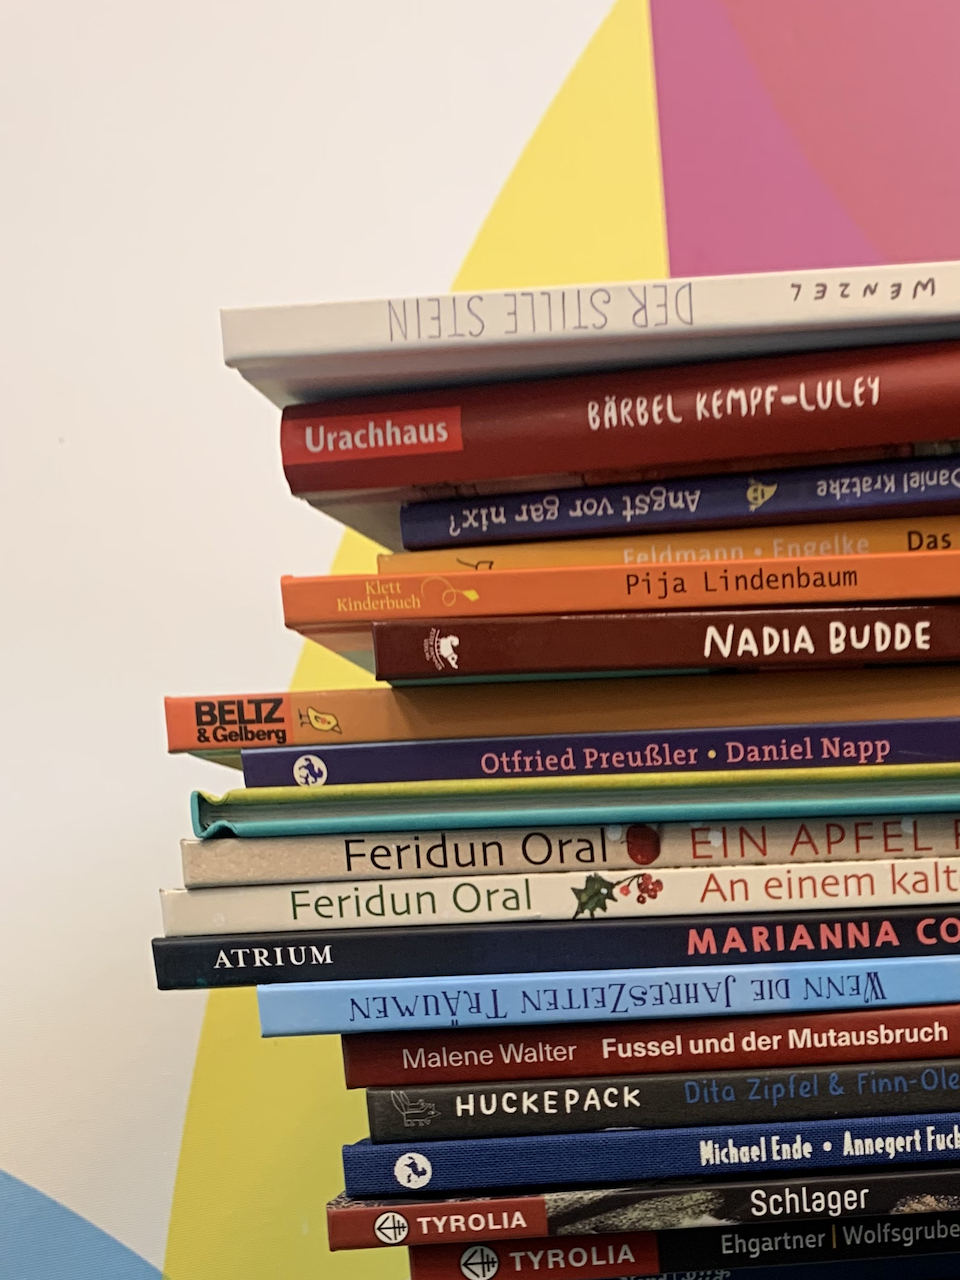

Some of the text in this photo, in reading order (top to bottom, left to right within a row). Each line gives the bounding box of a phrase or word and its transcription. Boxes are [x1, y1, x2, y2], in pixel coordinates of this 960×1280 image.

[387, 282, 694, 342] DER STILLE STEIN
[587, 375, 880, 430] BÄRBEL KEMPF-LULEY
[304, 419, 449, 454] Urachhaus
[817, 474, 895, 497] Kratzke
[449, 486, 700, 537] Angst vor gar nix?
[365, 581, 401, 596] Klett
[626, 567, 858, 599] Pija Lindenbaum
[337, 595, 421, 612] Kinderbuch
[703, 621, 931, 658] NADIA BUDDE
[195, 698, 285, 726] BELTZ
[196, 726, 287, 745] & Gelberg
[481, 736, 891, 775] Otfried Preußler Daniel Napp
[345, 828, 606, 872] Feridun Oral
[687, 921, 899, 955] MARIANNA
[213, 944, 333, 970] ATRIUM
[402, 1041, 577, 1070] Malene Walter
[602, 1023, 948, 1060] Fussel und der Mutausbruch
[684, 1079, 736, 1104] Dita
[746, 1071, 819, 1106] Zipfel
[829, 1073, 845, 1096] &
[857, 1064, 960, 1096] Finn-Ole
[455, 1086, 641, 1118] HUCKEPACK
[700, 1137, 768, 1166] Michael
[771, 1134, 813, 1162] Ende
[843, 1130, 921, 1160] Annegert
[749, 1186, 870, 1217] Schlager
[417, 1212, 527, 1235] TYROLIA
[721, 1225, 826, 1257] Ehgartner
